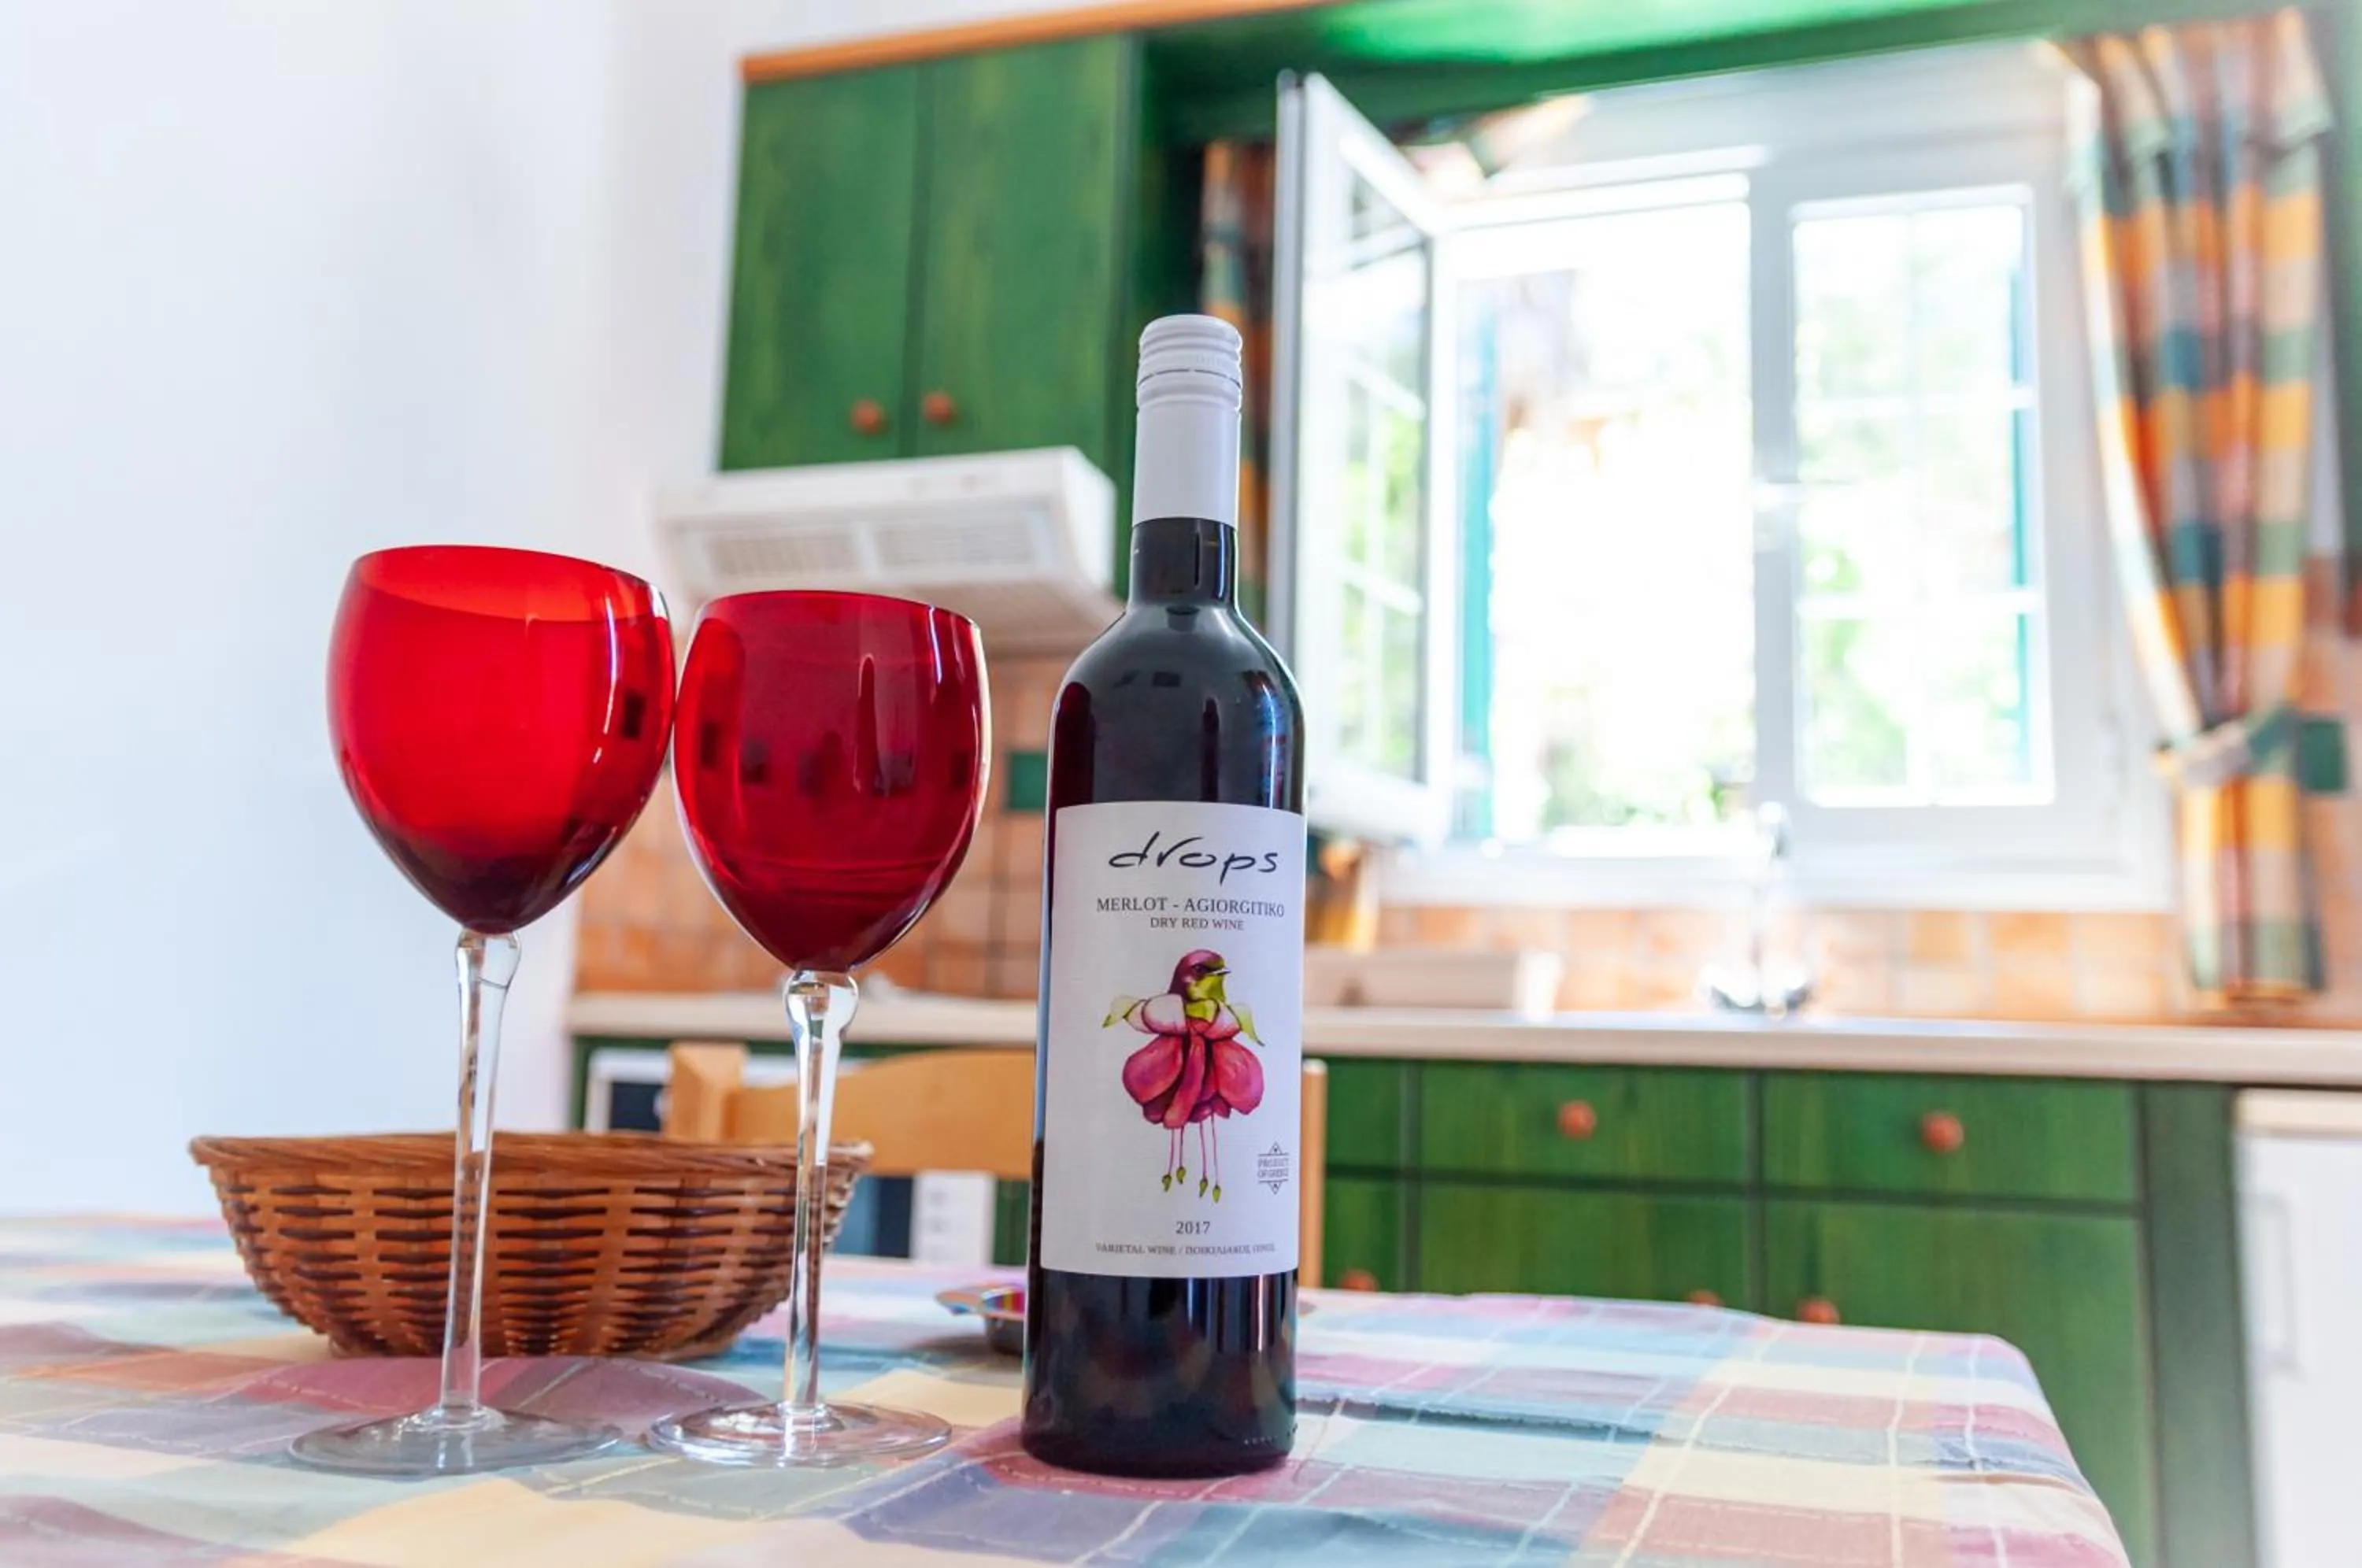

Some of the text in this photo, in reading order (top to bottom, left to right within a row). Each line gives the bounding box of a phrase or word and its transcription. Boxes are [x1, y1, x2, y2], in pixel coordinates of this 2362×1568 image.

[1109, 831, 1279, 886] drops
[1097, 897, 1168, 912] MERLOT
[1184, 898, 1285, 917] AGIORGITIKO
[1150, 918, 1245, 930] DRY RED WINE
[1175, 1221, 1210, 1234] 2017
[1095, 1242, 1145, 1254] VARIETAL
